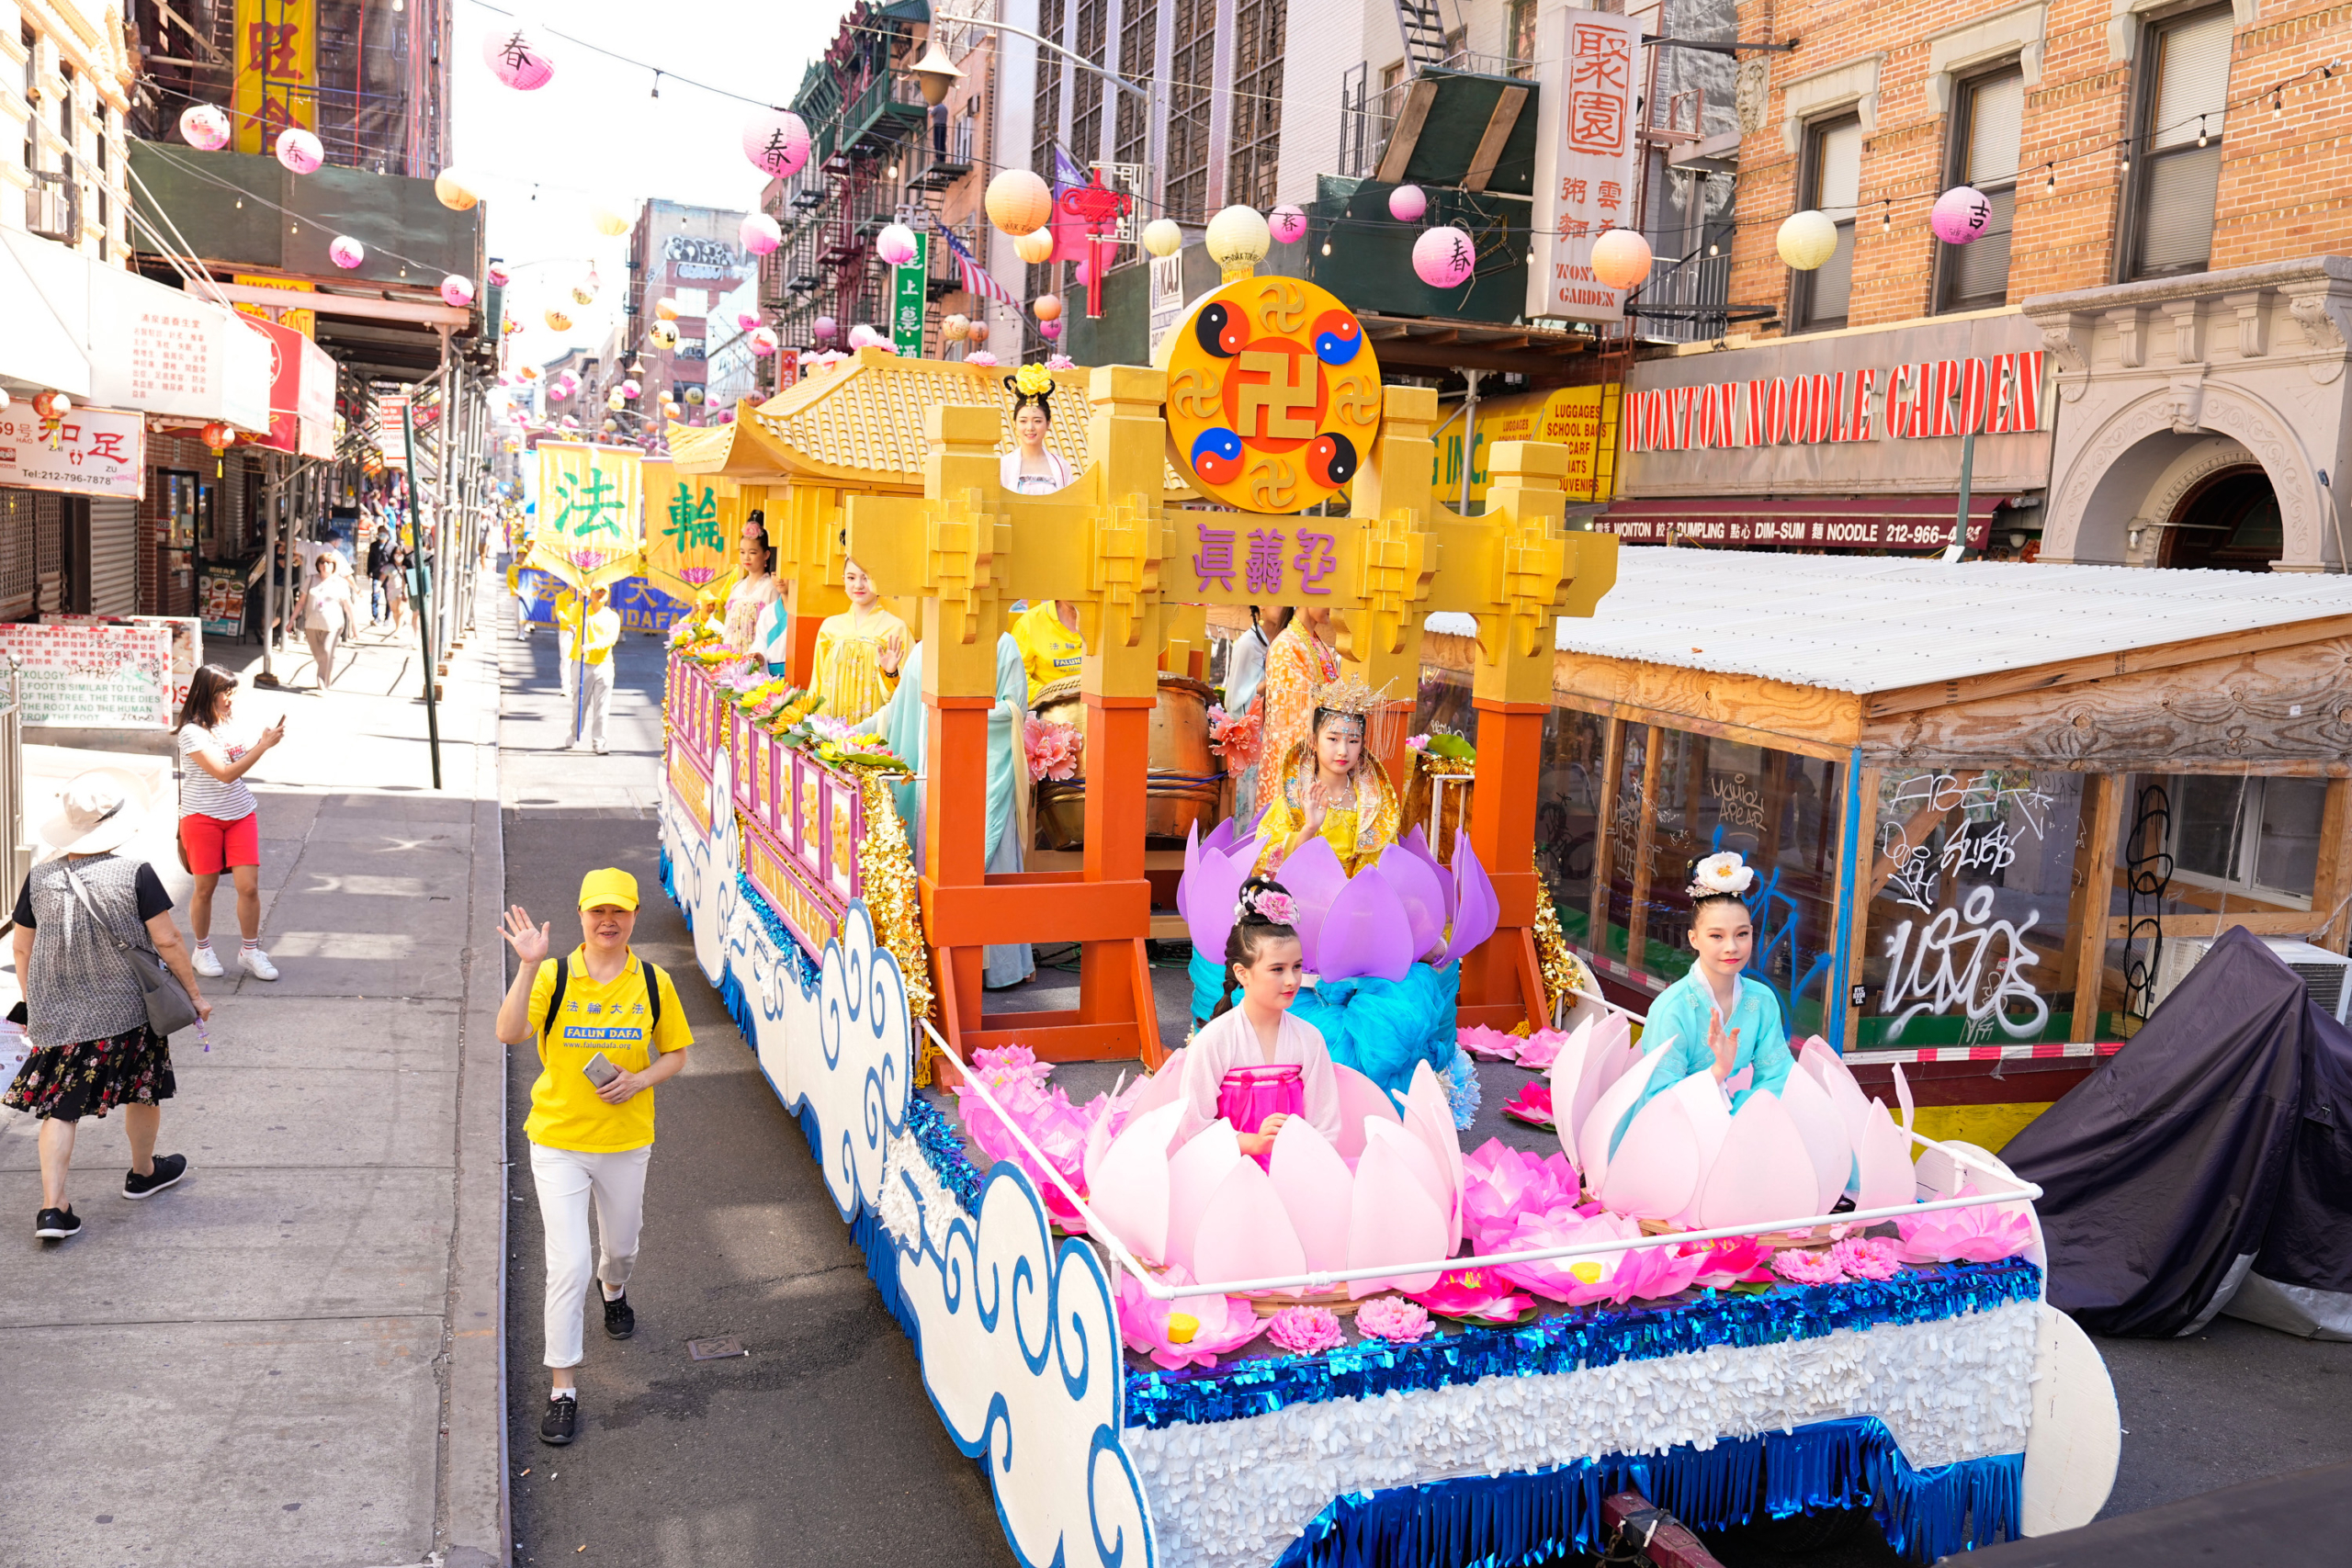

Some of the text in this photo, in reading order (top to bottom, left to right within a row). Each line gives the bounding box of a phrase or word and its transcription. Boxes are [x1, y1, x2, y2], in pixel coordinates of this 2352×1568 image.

[498, 28, 533, 71] 春
[284, 139, 304, 163] 春
[761, 128, 791, 167] 春
[1281, 212, 1298, 232] 春
[1448, 236, 1472, 274] 春
[1558, 288, 1615, 308] GARDEN
[1624, 350, 2046, 453] WONTON NOODLE GARDEN
[1555, 404, 1601, 419] LUGGAGES
[1502, 418, 1530, 433] LUGGAGES
[1546, 423, 1581, 437] SCHOOL
[16, 436, 33, 445] HAO
[106, 465, 118, 473] ZU
[22, 469, 112, 486] Tel:212-796-7878
[1558, 479, 1600, 492] OUVENIRS
[555, 468, 627, 539] 法
[662, 482, 725, 554] 輪
[1613, 522, 1651, 537] WONTON
[1676, 522, 1725, 539] DUMPLING
[1826, 523, 1879, 542] NOODLE
[1055, 658, 1080, 667] FALUN
[6, 682, 26, 690] TE
[28, 682, 54, 691] FOOT
[57, 682, 66, 691] IS
[69, 683, 108, 692] SIMILAR
[112, 684, 123, 693] TO
[38, 693, 55, 701] THE
[90, 694, 107, 702] THE
[111, 694, 136, 703] TREE
[139, 695, 161, 704] DIES
[22, 703, 40, 711] THE
[74, 704, 94, 712] AND
[51, 713, 71, 721] THE
[566, 1000, 645, 1015] 法輪大法
[566, 1028, 640, 1039] FALUN DAFA
[563, 1041, 632, 1050] www.falundafa.org
